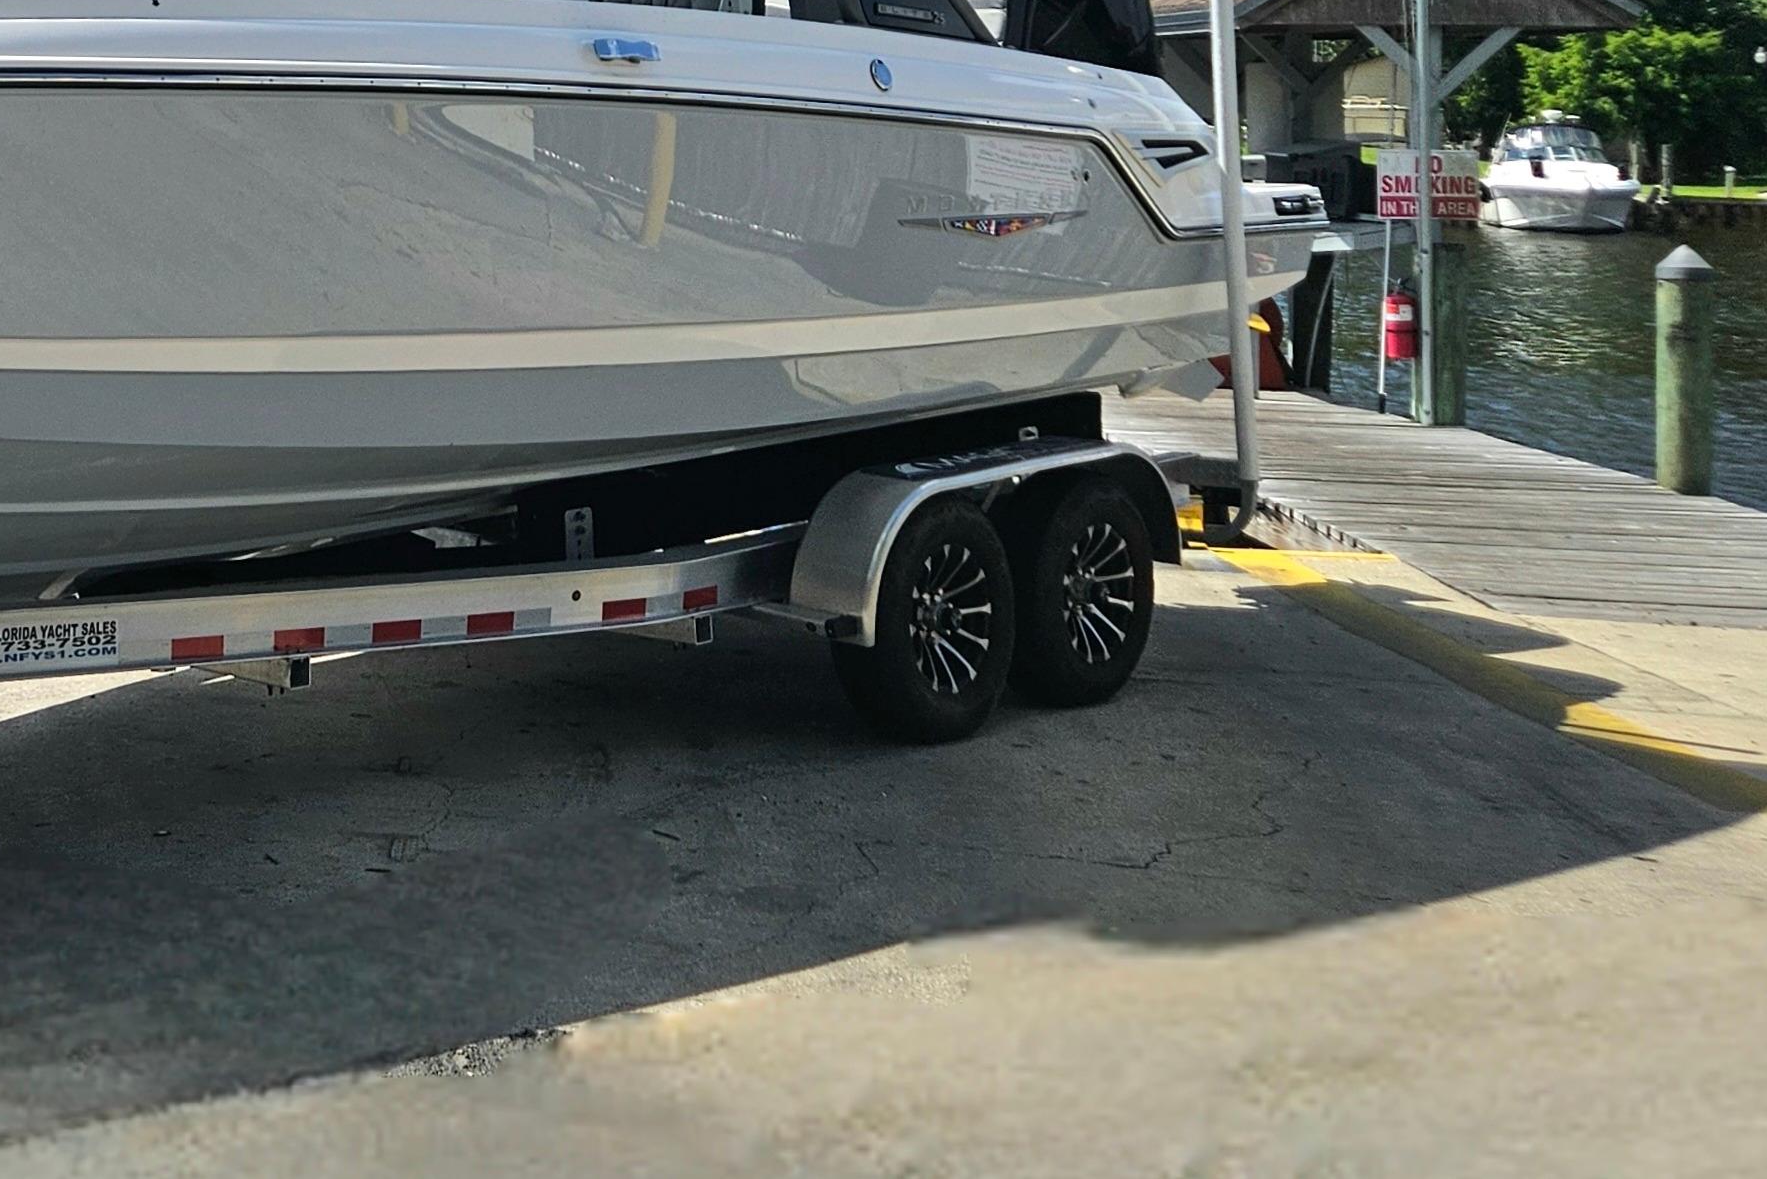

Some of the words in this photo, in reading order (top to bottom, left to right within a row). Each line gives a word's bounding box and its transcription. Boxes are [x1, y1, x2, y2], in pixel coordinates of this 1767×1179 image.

[1382, 201, 1397, 215] IN
[1437, 202, 1476, 216] AREA
[40, 623, 79, 639] YACHT
[81, 621, 117, 636] SALES
